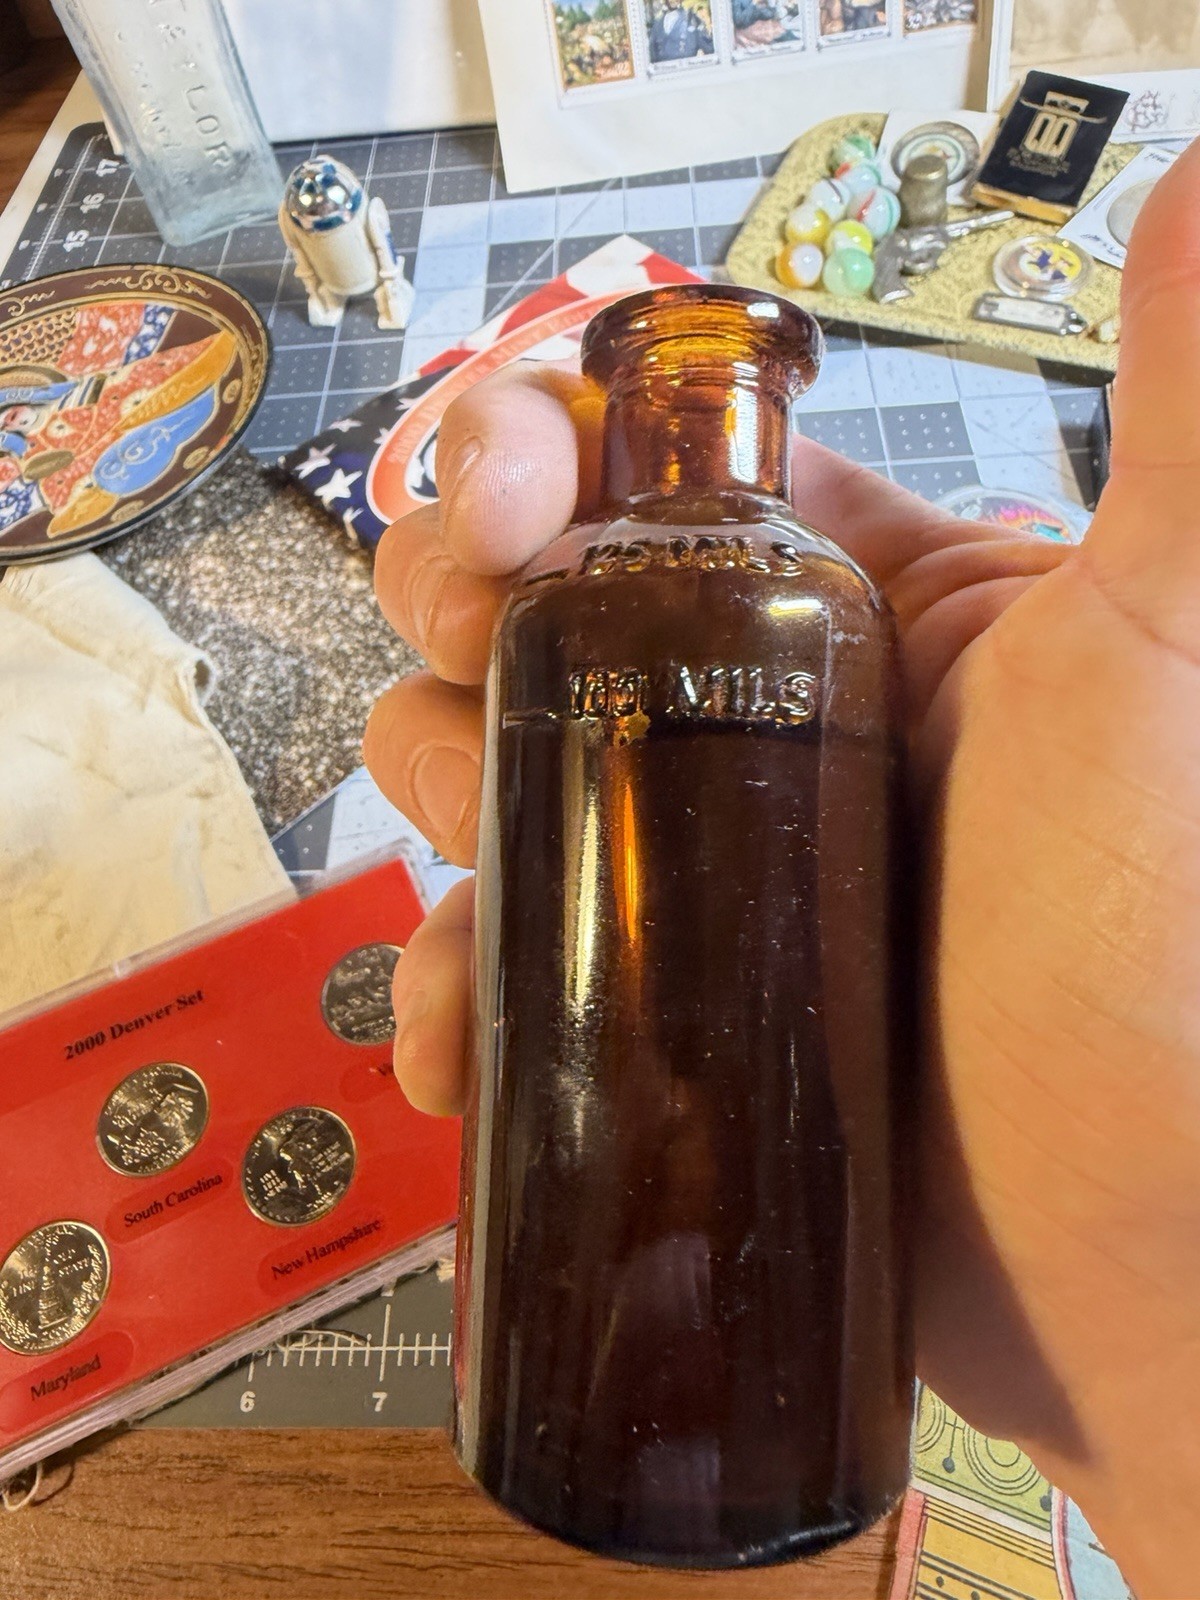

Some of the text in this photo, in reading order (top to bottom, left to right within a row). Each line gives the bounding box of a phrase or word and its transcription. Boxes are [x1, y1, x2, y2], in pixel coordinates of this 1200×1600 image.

[95, 158, 121, 178] 17
[80, 192, 105, 214] 16
[63, 229, 90, 252] 15
[664, 661, 816, 724] MILS
[64, 990, 204, 1060] 2000 Denver Set
[124, 1201, 164, 1228] South
[165, 1174, 223, 1208] Carolina
[271, 1219, 383, 1280] New Hampshire
[30, 1352, 102, 1401] Maryland
[239, 1390, 256, 1413] 6
[371, 1391, 388, 1412] 7
